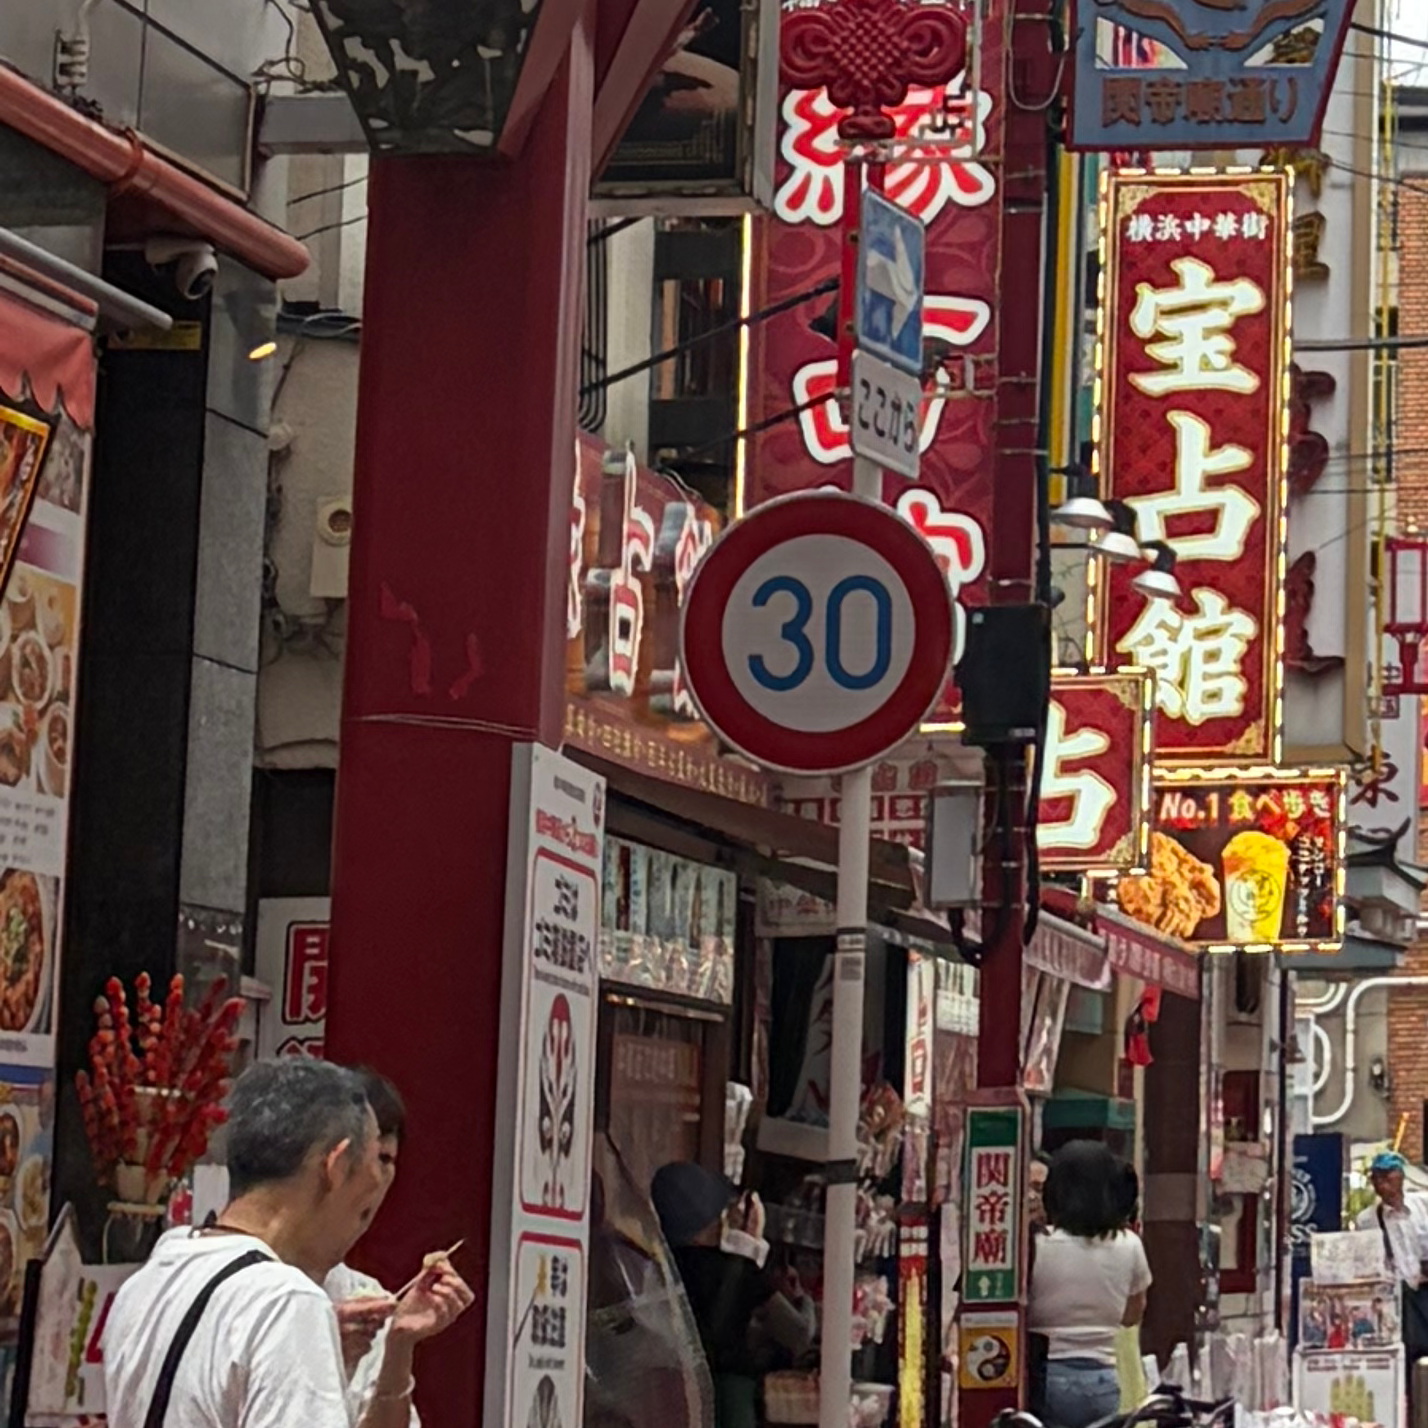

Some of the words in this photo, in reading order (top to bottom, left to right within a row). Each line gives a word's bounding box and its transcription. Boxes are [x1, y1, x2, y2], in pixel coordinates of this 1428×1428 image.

[1126, 212, 1269, 242] 横浜中華街
[858, 378, 917, 454] ここから
[1115, 255, 1267, 727] 宝占館
[748, 574, 892, 692] 30
[1160, 792, 1219, 821] No.1
[973, 1151, 1011, 1264] 関帝廟
